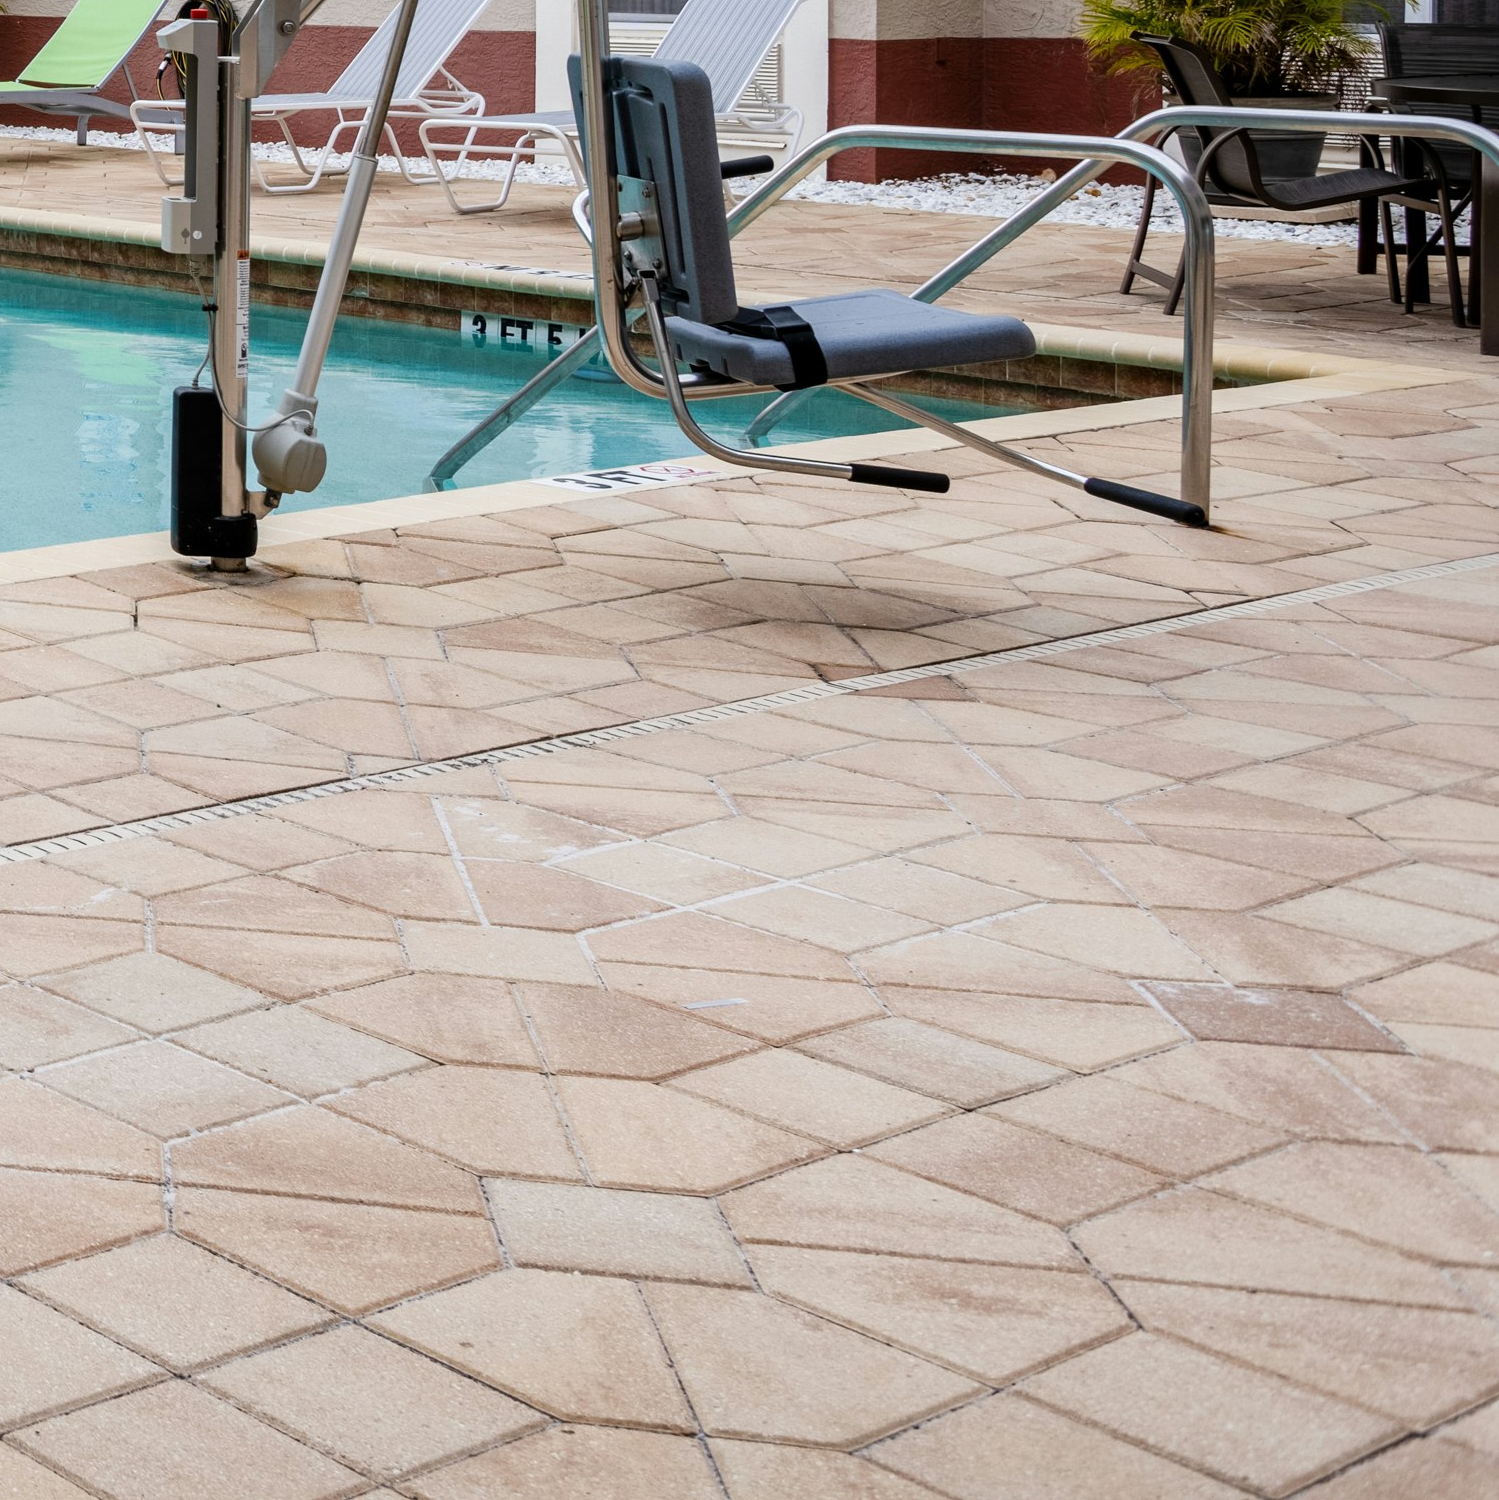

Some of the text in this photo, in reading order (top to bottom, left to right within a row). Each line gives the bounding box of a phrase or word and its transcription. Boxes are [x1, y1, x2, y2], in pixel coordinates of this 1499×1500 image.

[501, 318, 533, 341] FT
[548, 323, 563, 345] 5
[552, 477, 613, 489] 3
[584, 470, 668, 485] FT
